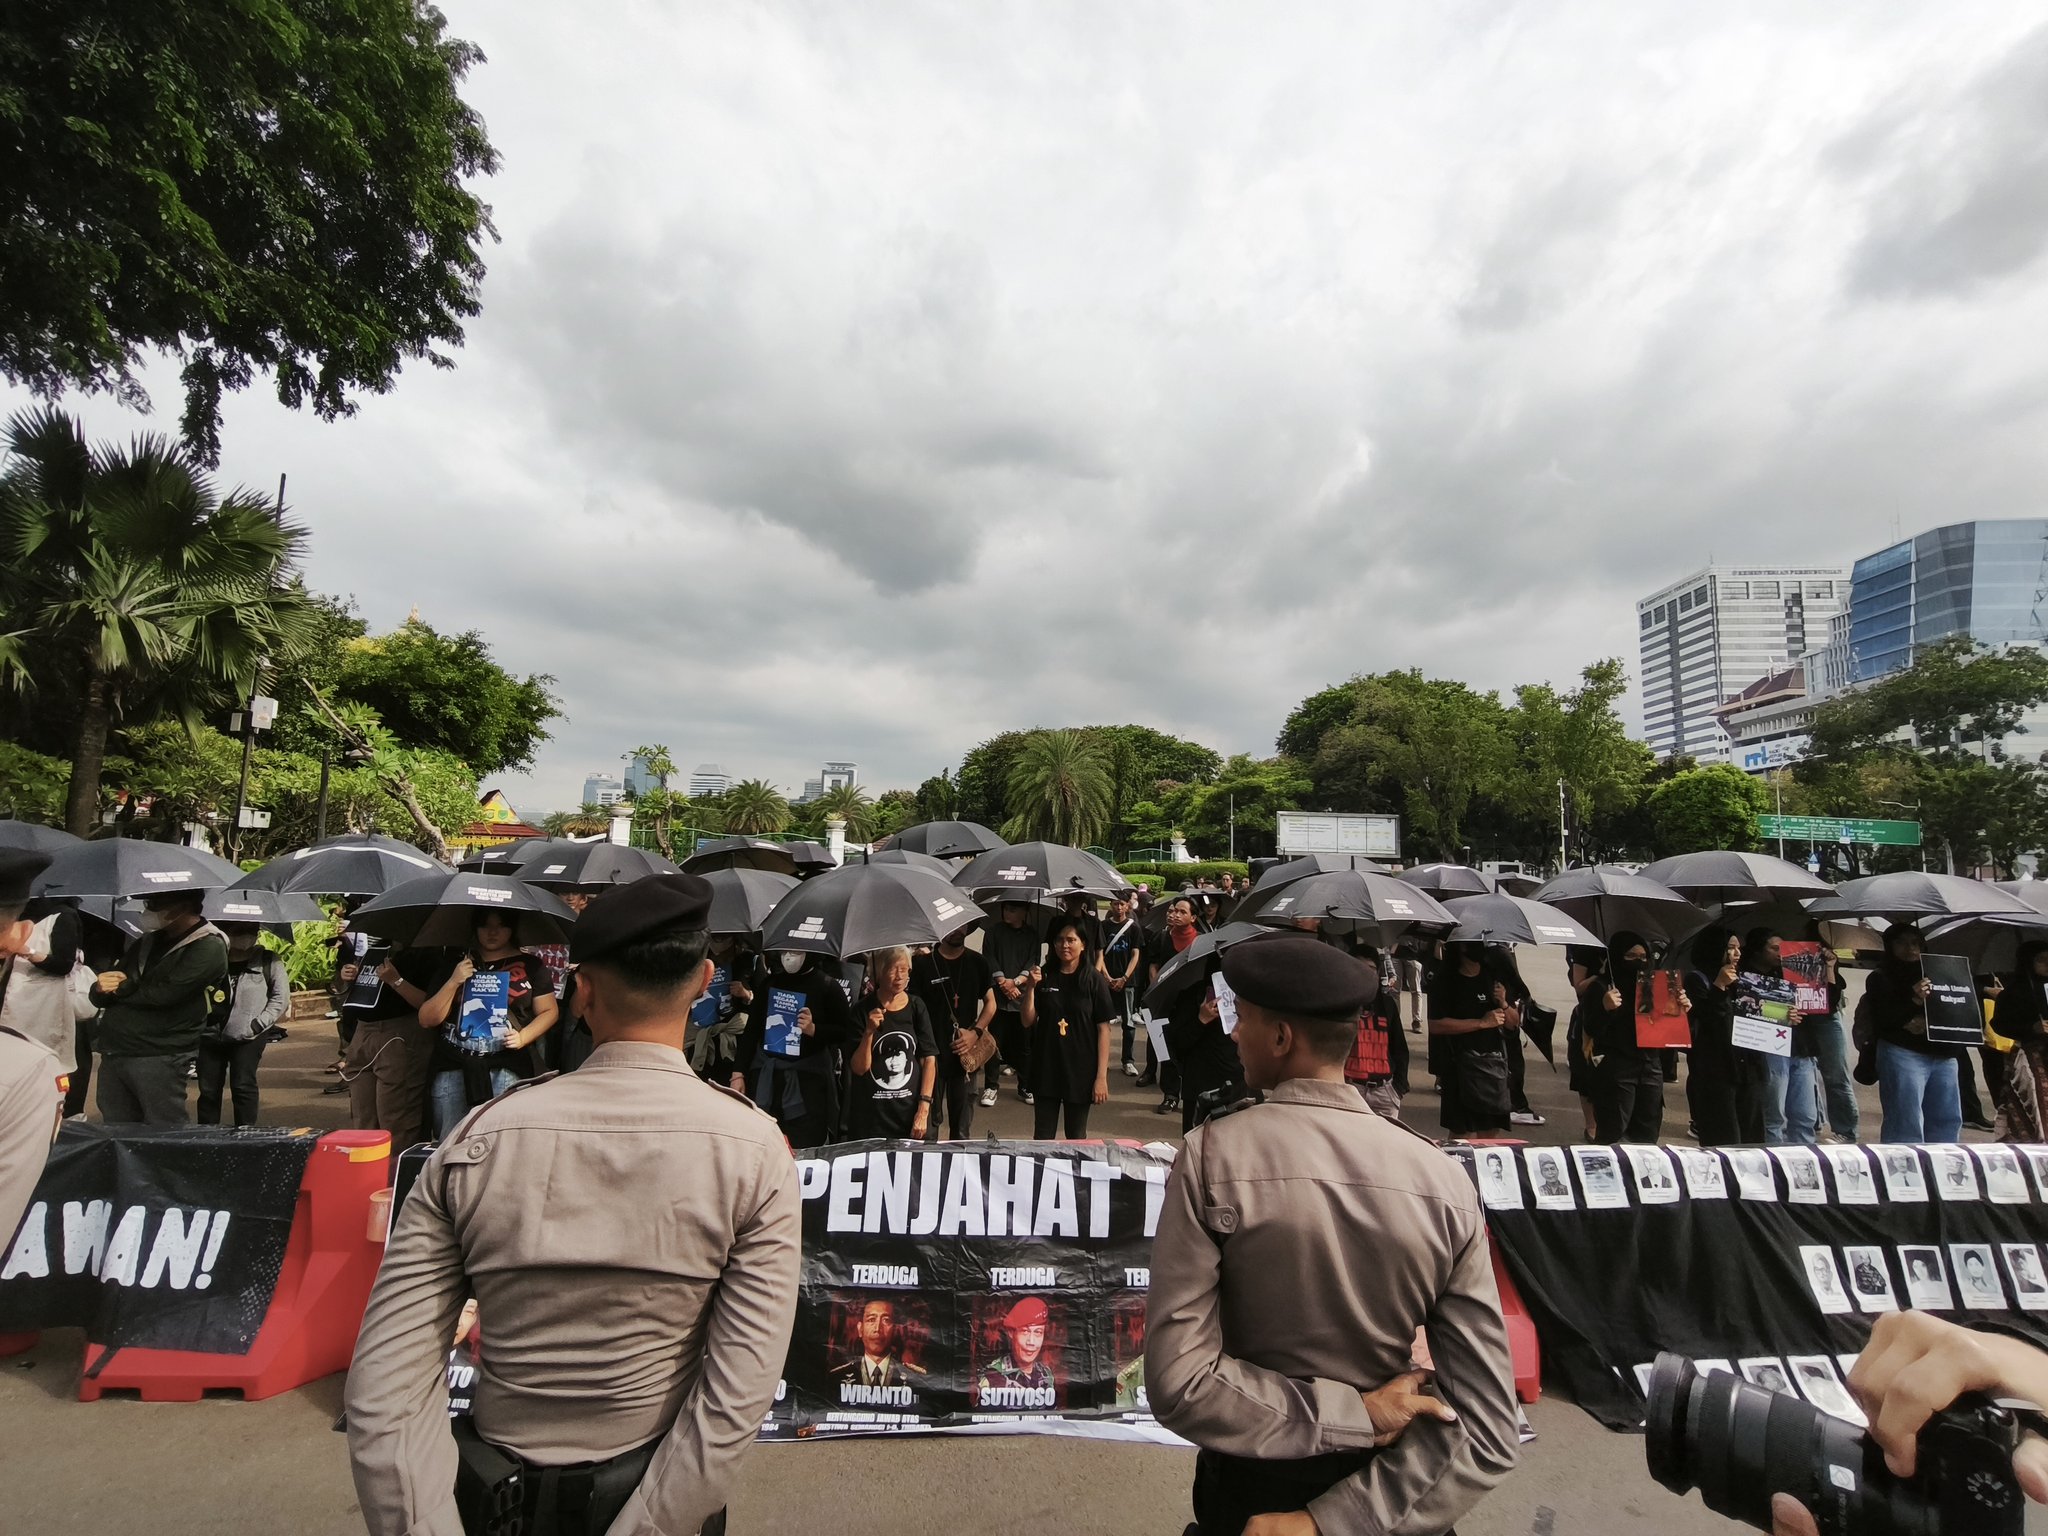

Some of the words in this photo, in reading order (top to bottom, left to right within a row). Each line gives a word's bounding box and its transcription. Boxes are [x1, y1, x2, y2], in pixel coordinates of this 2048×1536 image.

[777, 991, 796, 1000] TIADA
[1928, 983, 1951, 992] Tanah
[797, 1151, 1122, 1238] PENJAHAT
[852, 1264, 919, 1286] TERDUGA
[990, 1267, 1056, 1286] TERDUGA
[840, 1383, 912, 1405] WIRANTO
[980, 1387, 1056, 1407] SUTIYOSO
[901, 1414, 920, 1424] ATAS
